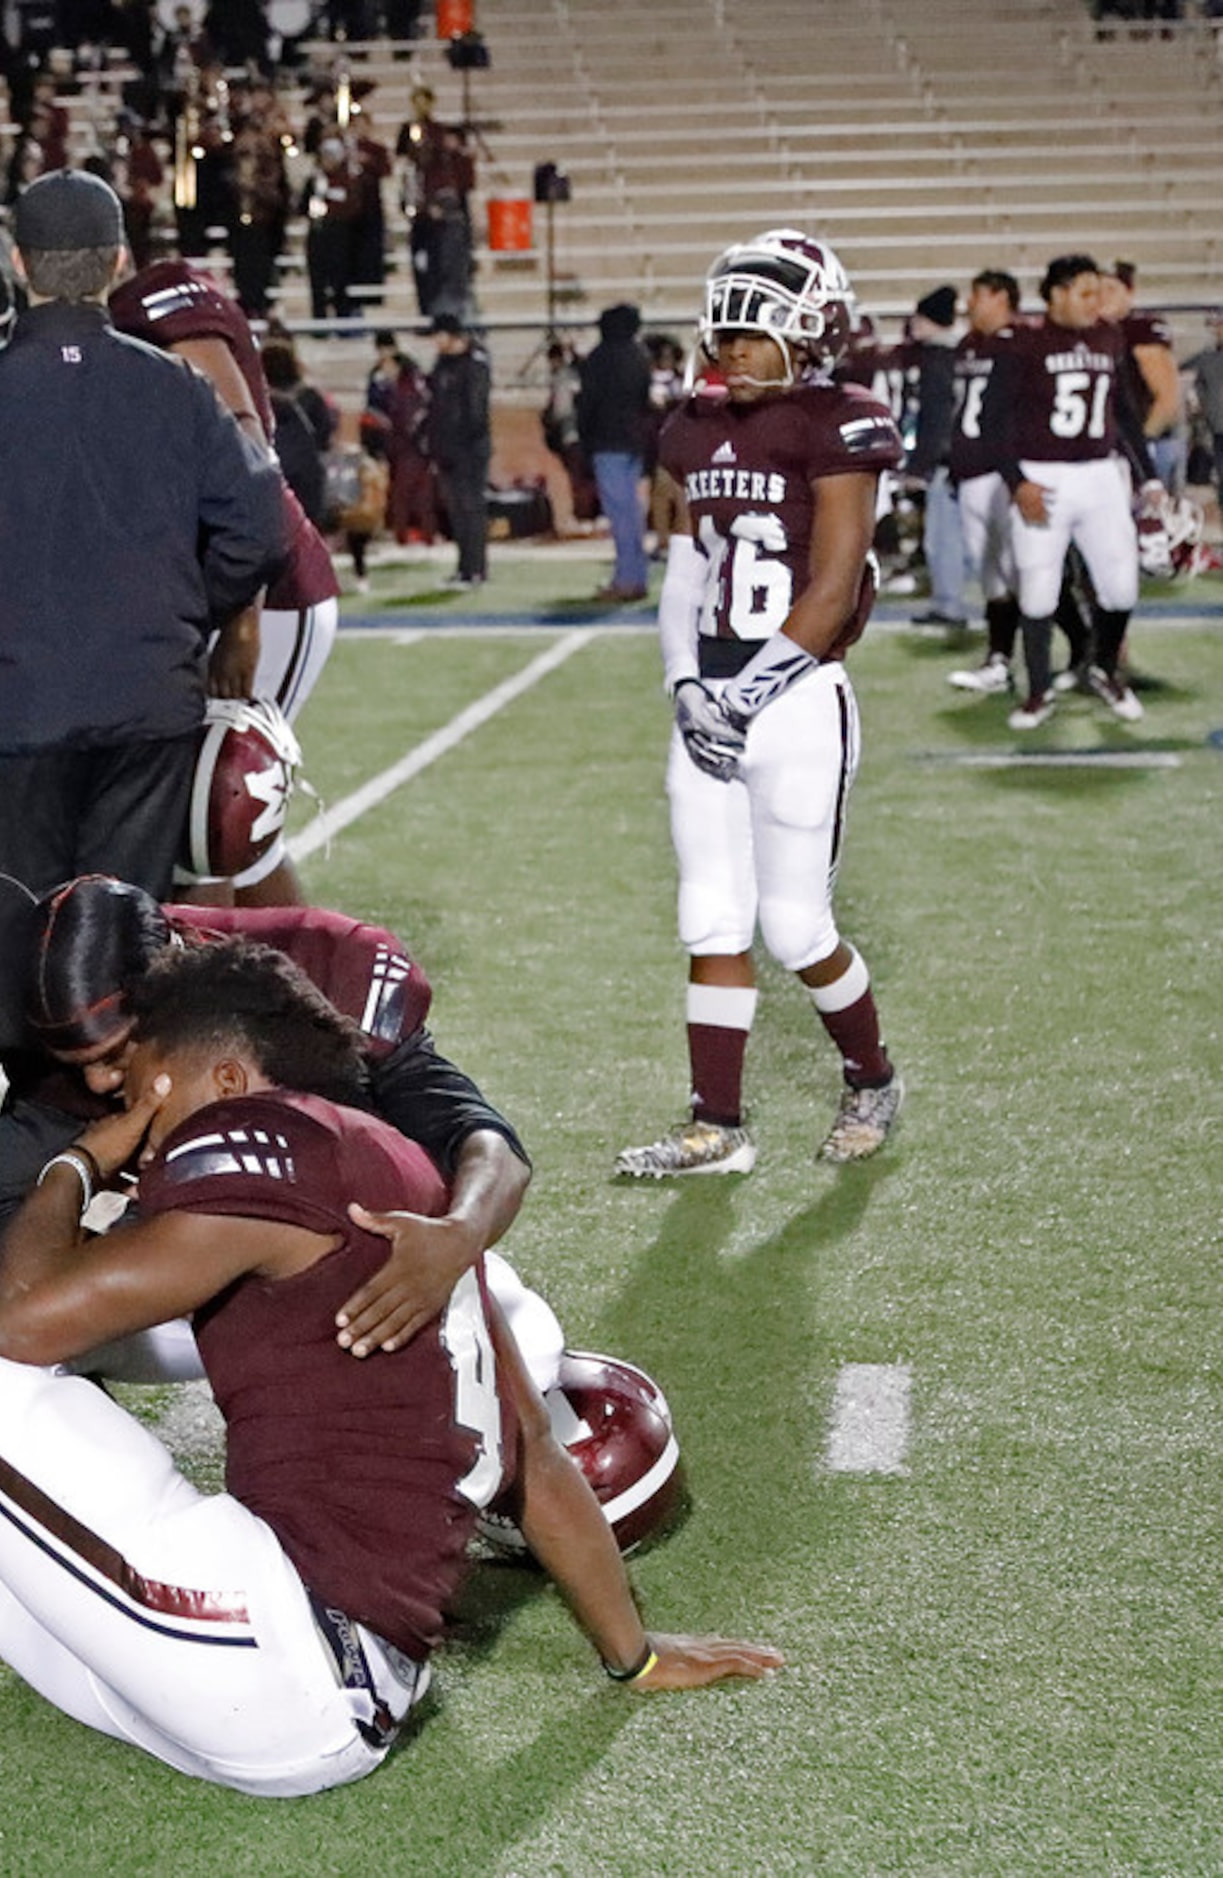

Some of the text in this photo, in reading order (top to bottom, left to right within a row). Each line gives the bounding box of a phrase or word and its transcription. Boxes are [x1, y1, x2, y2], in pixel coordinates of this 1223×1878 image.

[61, 345, 82, 363] 15
[1050, 373, 1111, 439] 51
[685, 469, 787, 504] KEETERS
